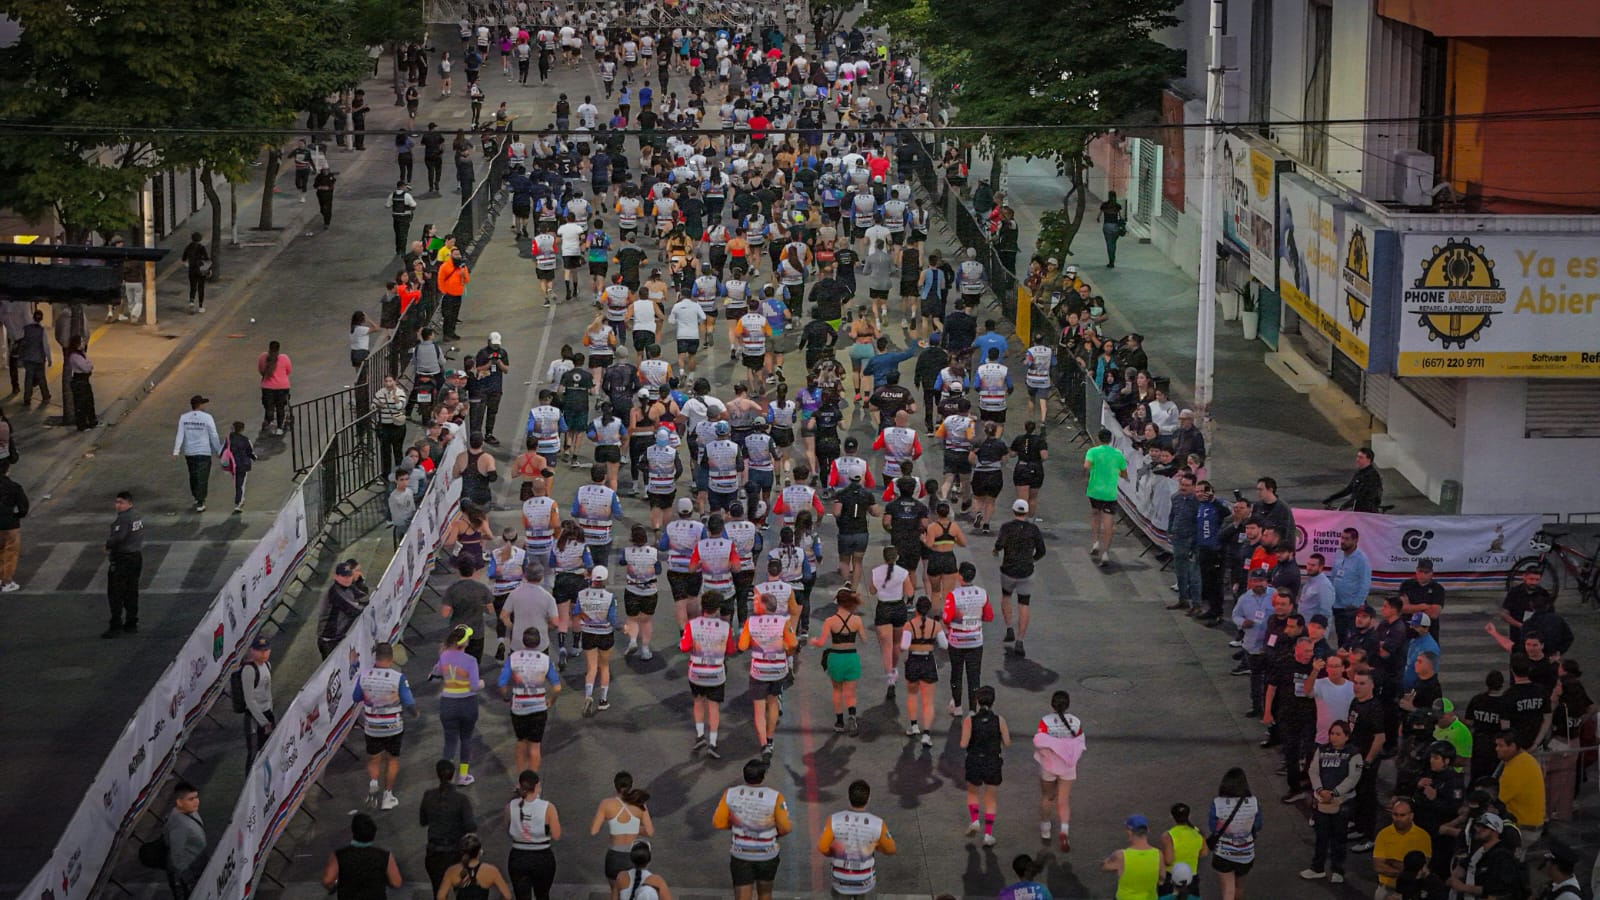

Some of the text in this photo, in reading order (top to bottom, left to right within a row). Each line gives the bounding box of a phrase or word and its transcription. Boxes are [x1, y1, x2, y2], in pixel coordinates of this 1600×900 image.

[1515, 249, 1555, 278] Ya
[1404, 291, 1506, 304] PHONE MASTERS
[1421, 357, 1485, 369] (667) 220 9711
[1531, 353, 1567, 362] Software
[1313, 537, 1339, 546] Nueva
[1516, 698, 1543, 712] STAFF
